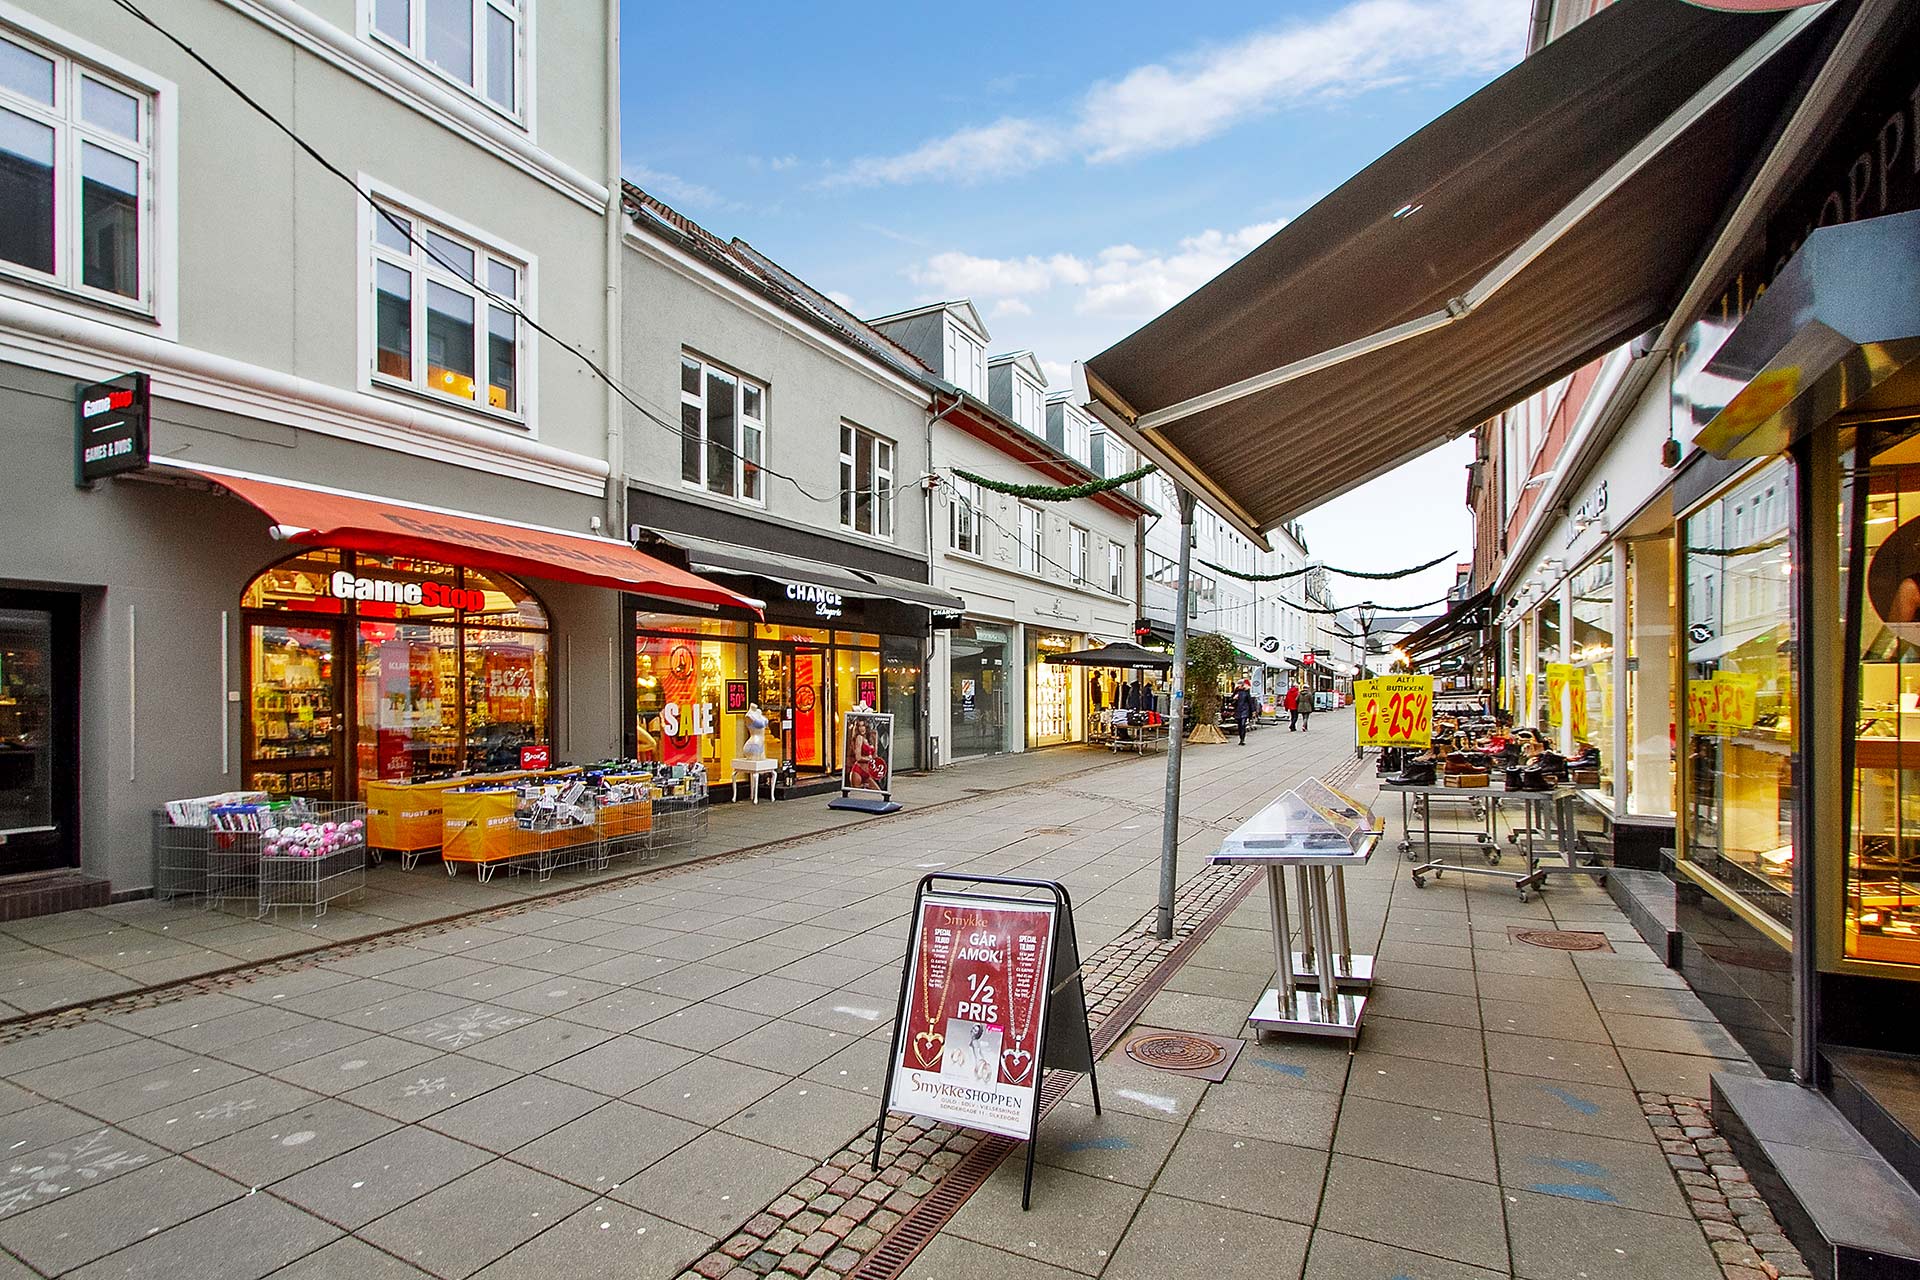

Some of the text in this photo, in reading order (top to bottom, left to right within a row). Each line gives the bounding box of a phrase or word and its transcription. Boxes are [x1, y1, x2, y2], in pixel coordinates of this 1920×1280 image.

[332, 570, 485, 612] GameStop
[786, 584, 842, 605] CHANGE
[490, 667, 531, 686] 50%
[664, 702, 714, 736] SALE
[943, 910, 989, 930] Smykke
[969, 930, 997, 947] GÅR
[957, 947, 1004, 964] AMOK!
[967, 973, 995, 1004] 1/2
[957, 1001, 999, 1023] PRIS
